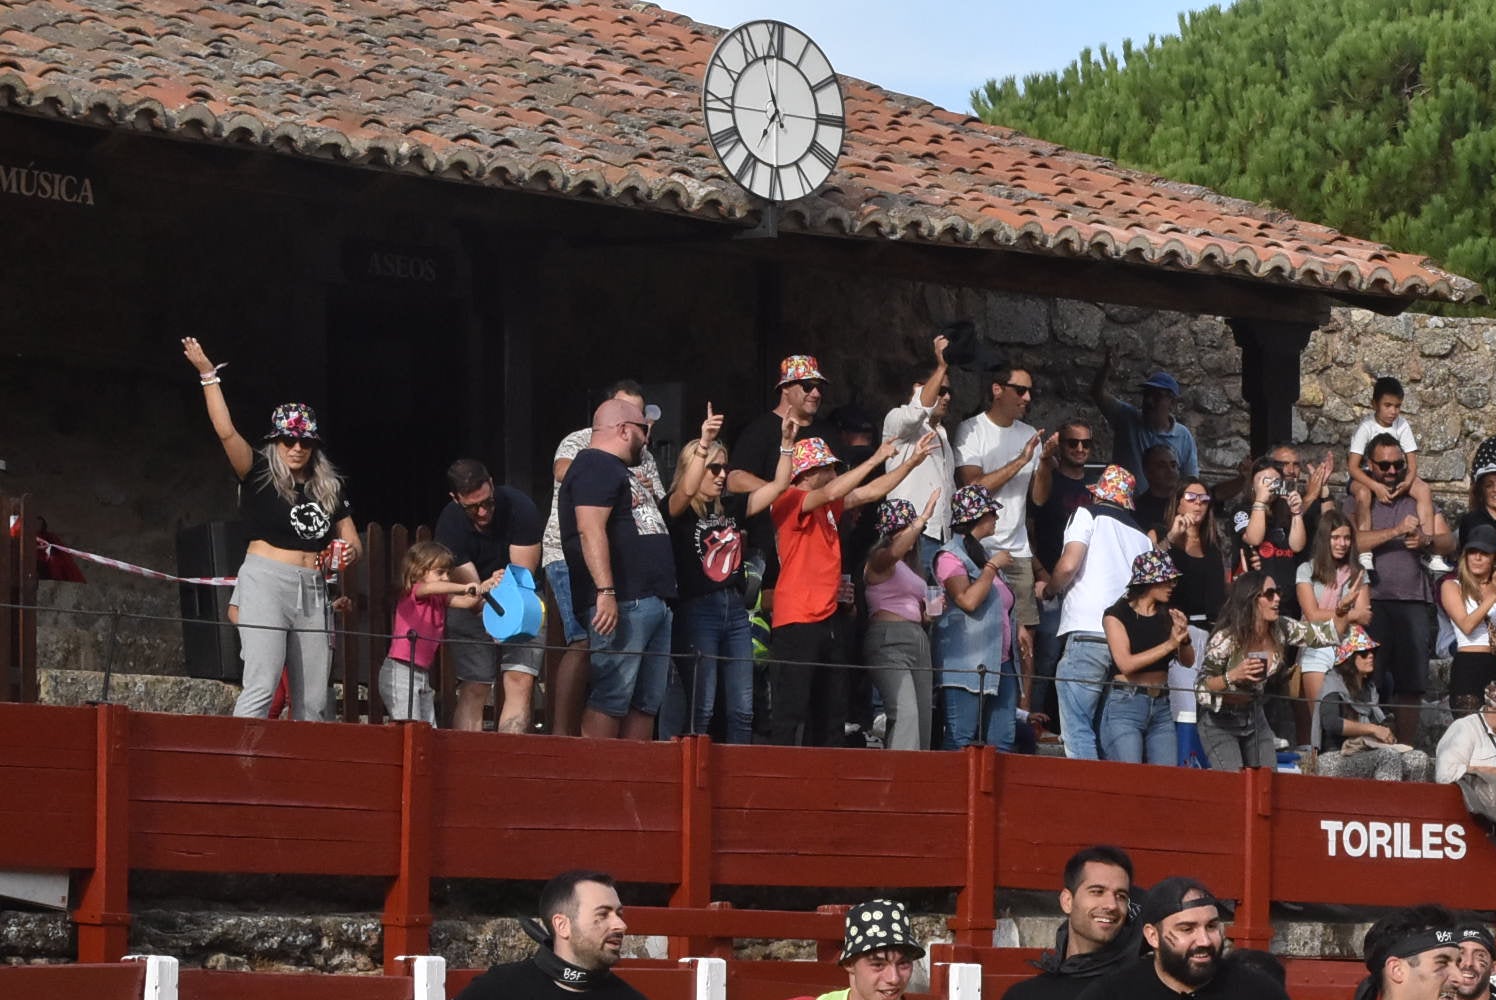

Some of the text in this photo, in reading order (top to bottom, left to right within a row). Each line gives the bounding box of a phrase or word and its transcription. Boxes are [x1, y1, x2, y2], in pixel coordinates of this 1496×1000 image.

[0, 161, 95, 205] MÚSICA
[368, 253, 436, 282] ASEOS
[1320, 820, 1467, 860] TORILES
[564, 968, 587, 980] BSF
